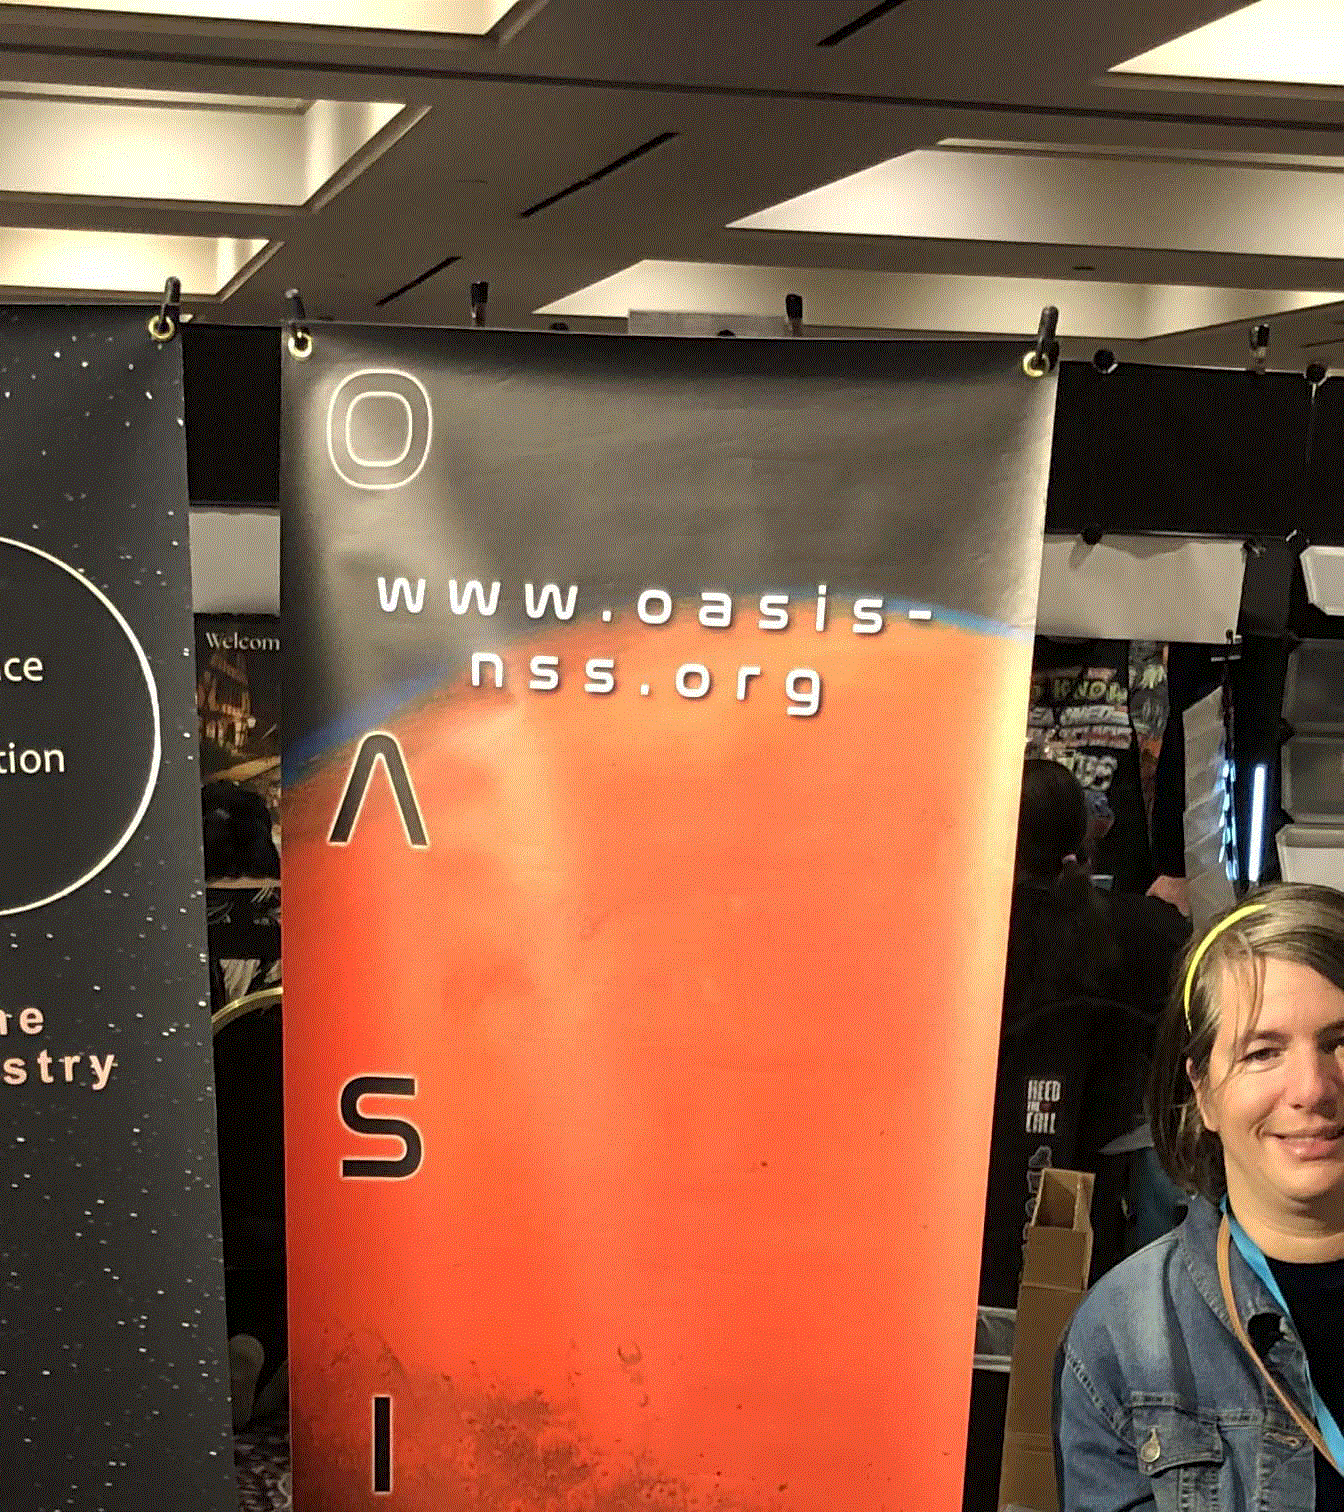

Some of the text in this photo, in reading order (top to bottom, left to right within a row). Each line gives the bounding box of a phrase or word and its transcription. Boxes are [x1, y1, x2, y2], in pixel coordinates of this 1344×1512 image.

[378, 573, 933, 634] www.oasis-
[206, 632, 280, 651] Welcom
[471, 650, 823, 716] nss.org
